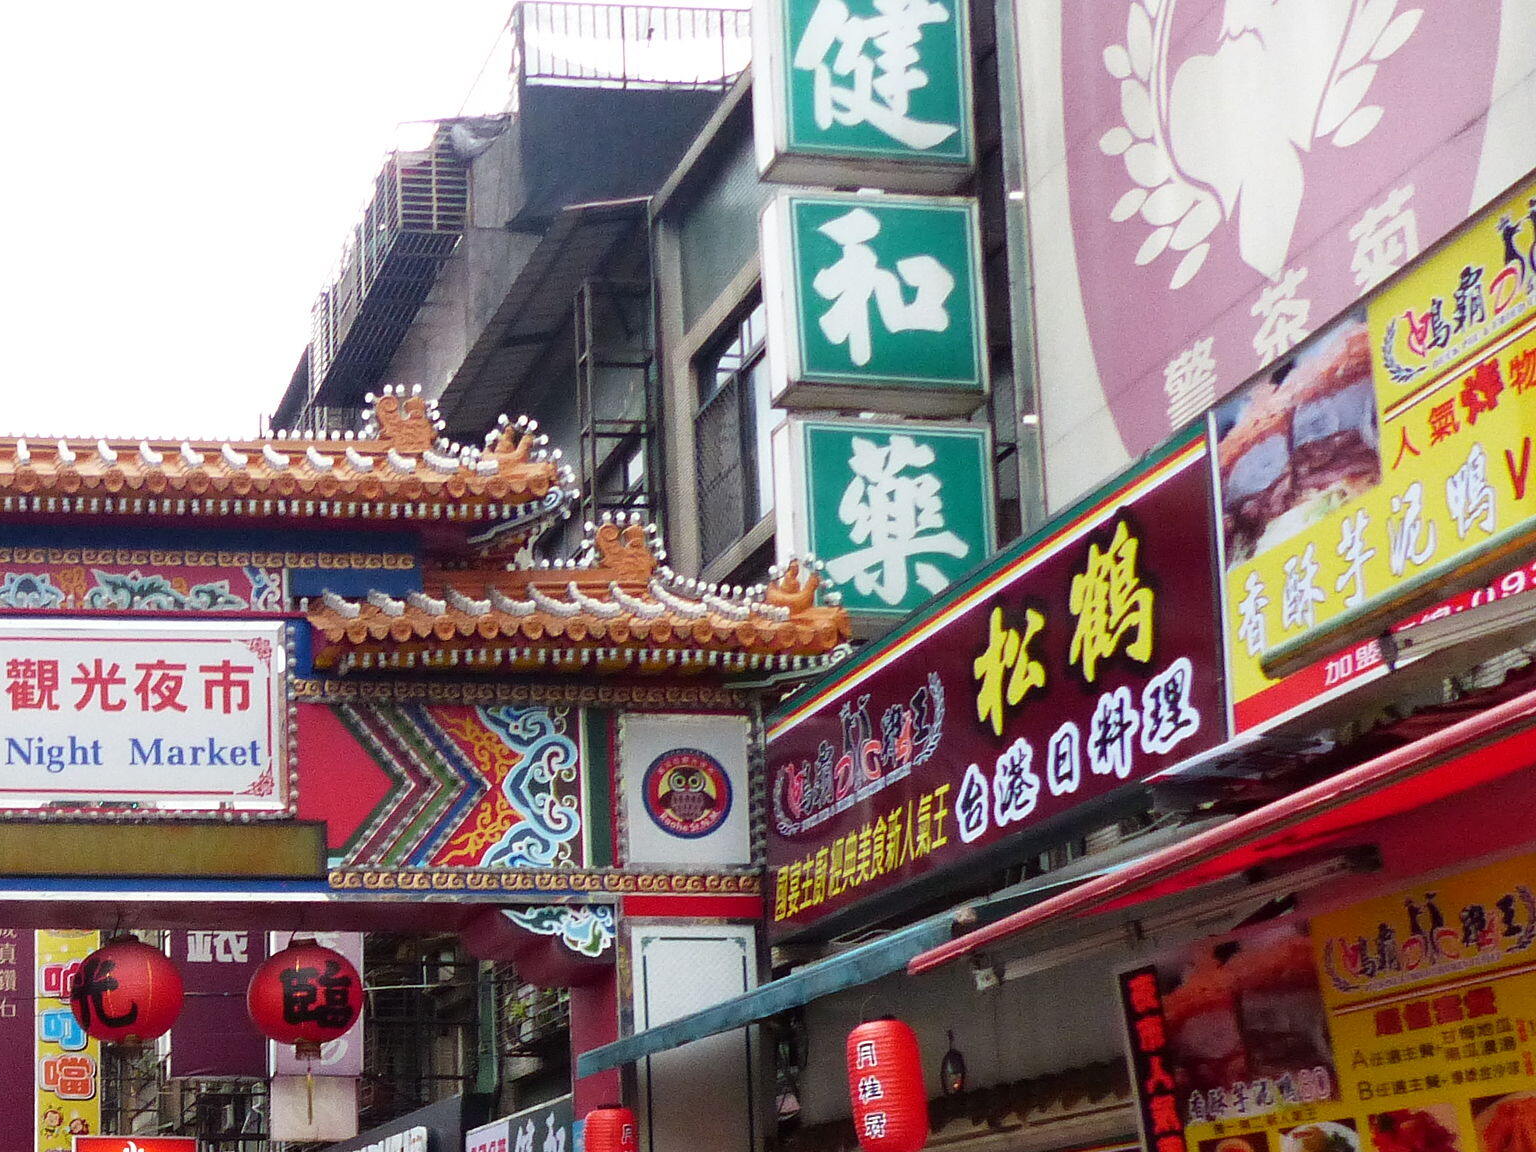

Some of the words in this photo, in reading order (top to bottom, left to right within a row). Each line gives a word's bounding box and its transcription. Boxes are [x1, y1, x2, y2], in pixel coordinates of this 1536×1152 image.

[974, 521, 1154, 736] 松鶴
[5, 735, 104, 773] Night
[128, 736, 262, 767] Market
[956, 656, 1201, 843] 台港日料理
[71, 957, 138, 1031] 光
[279, 960, 353, 1028] 臨
